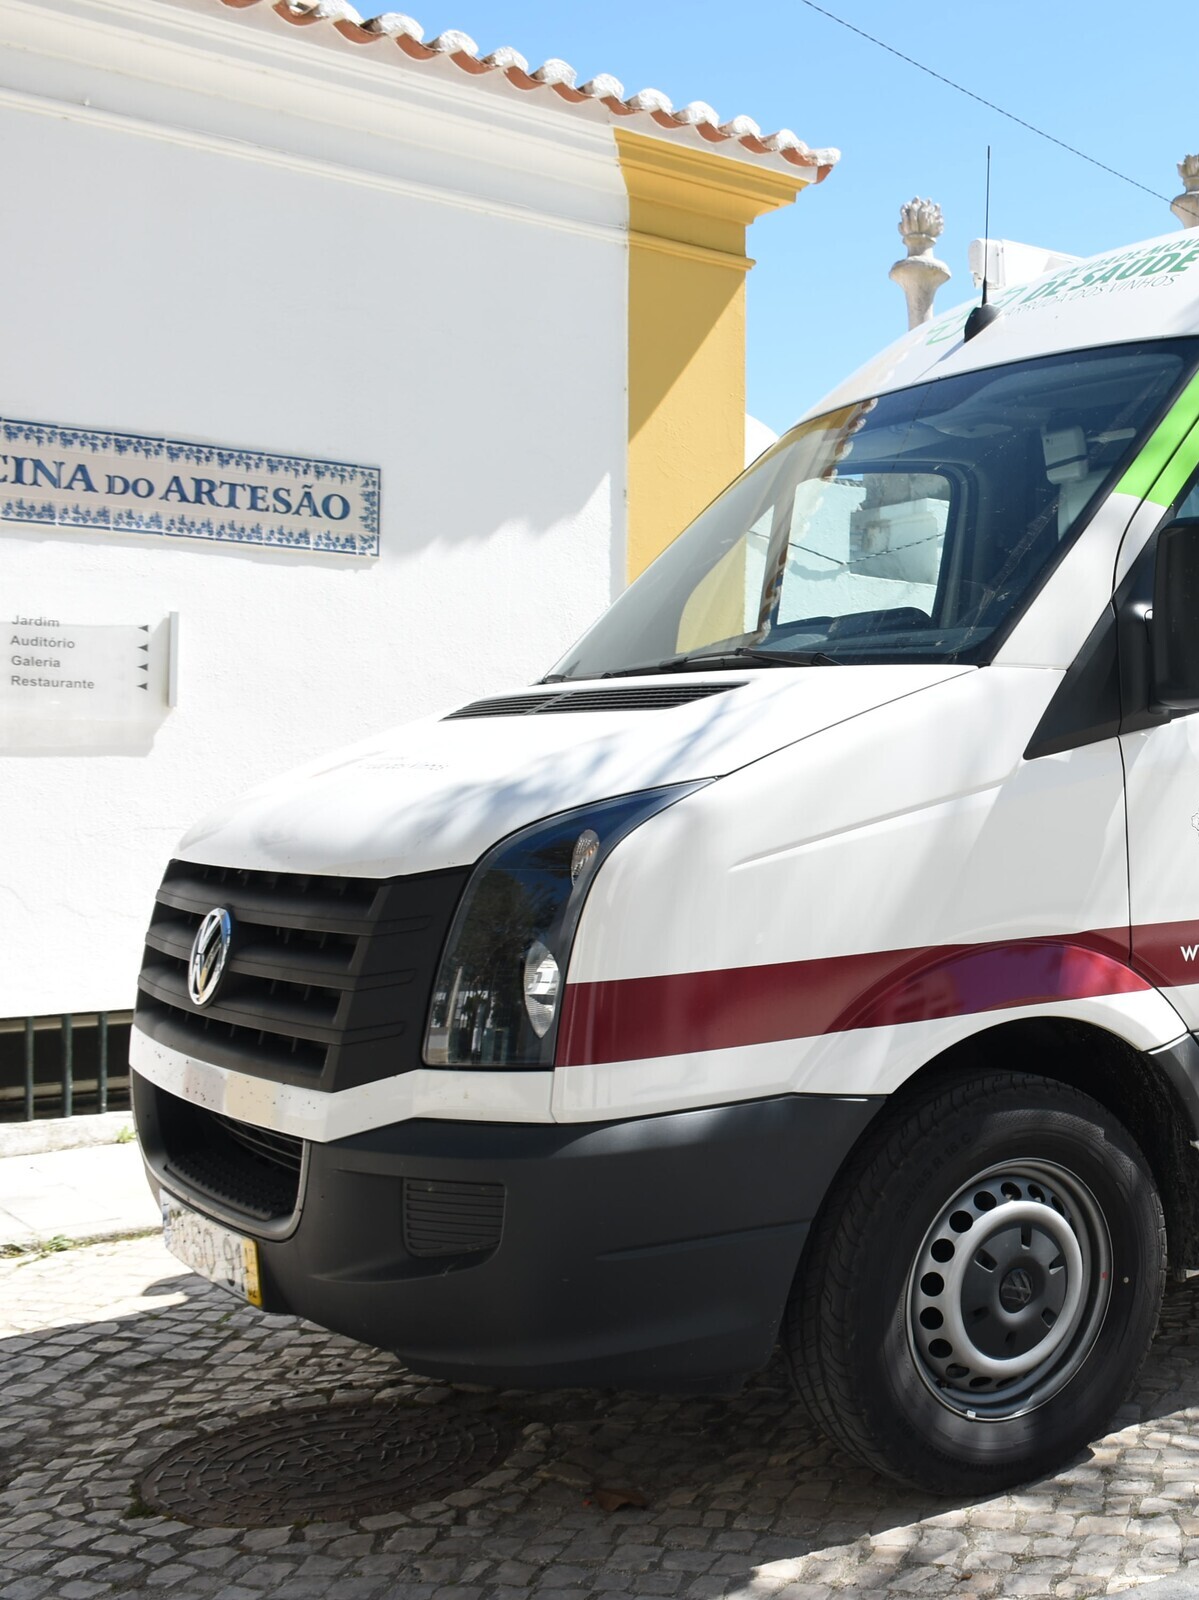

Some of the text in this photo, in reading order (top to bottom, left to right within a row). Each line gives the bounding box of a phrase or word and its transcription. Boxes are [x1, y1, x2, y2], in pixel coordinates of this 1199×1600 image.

[105, 474, 155, 499] DO
[159, 475, 352, 521] ARTESÃO
[11, 615, 61, 628] Jardim
[10, 635, 76, 649] Auditório
[11, 655, 62, 669] Galeria
[10, 675, 95, 690] Restaurante
